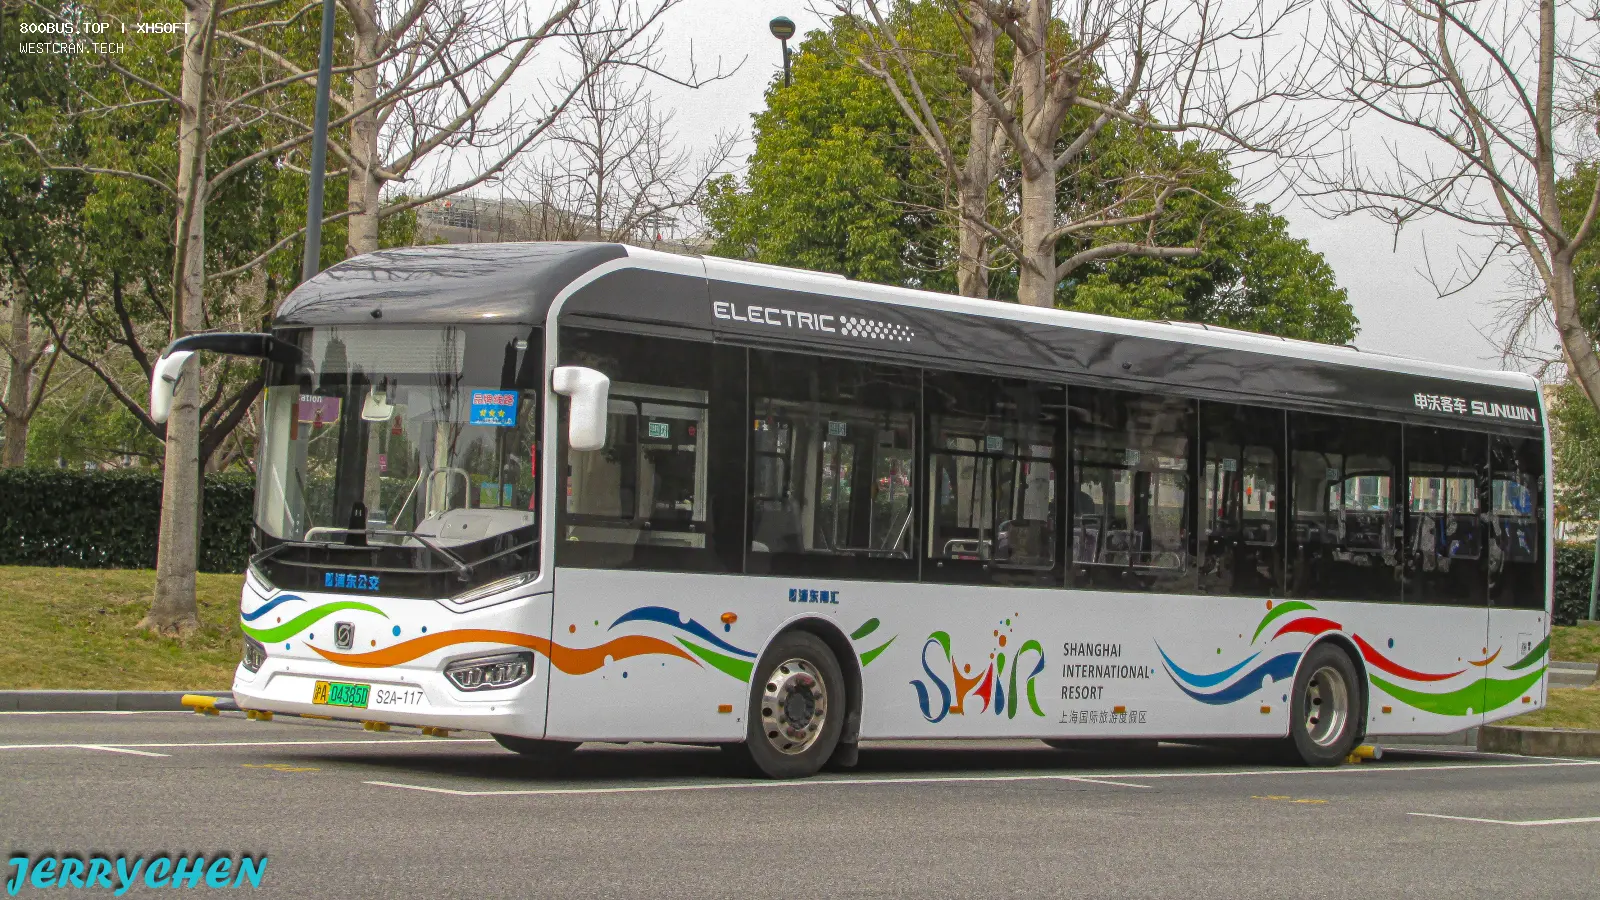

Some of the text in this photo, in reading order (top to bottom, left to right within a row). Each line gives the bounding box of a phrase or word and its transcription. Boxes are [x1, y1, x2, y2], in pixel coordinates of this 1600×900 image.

[713, 300, 836, 333] ELECTRIC
[298, 394, 322, 403] ation
[1414, 392, 1537, 422] 申沃客车 SUNWIN
[1063, 642, 1121, 657] SHANGHAI
[1062, 664, 1150, 679] INTERNATIONAL
[376, 689, 423, 705] S2A-117
[1061, 685, 1104, 700] RESORT
[1058, 709, 1148, 724] 上海国际旅游度假区
